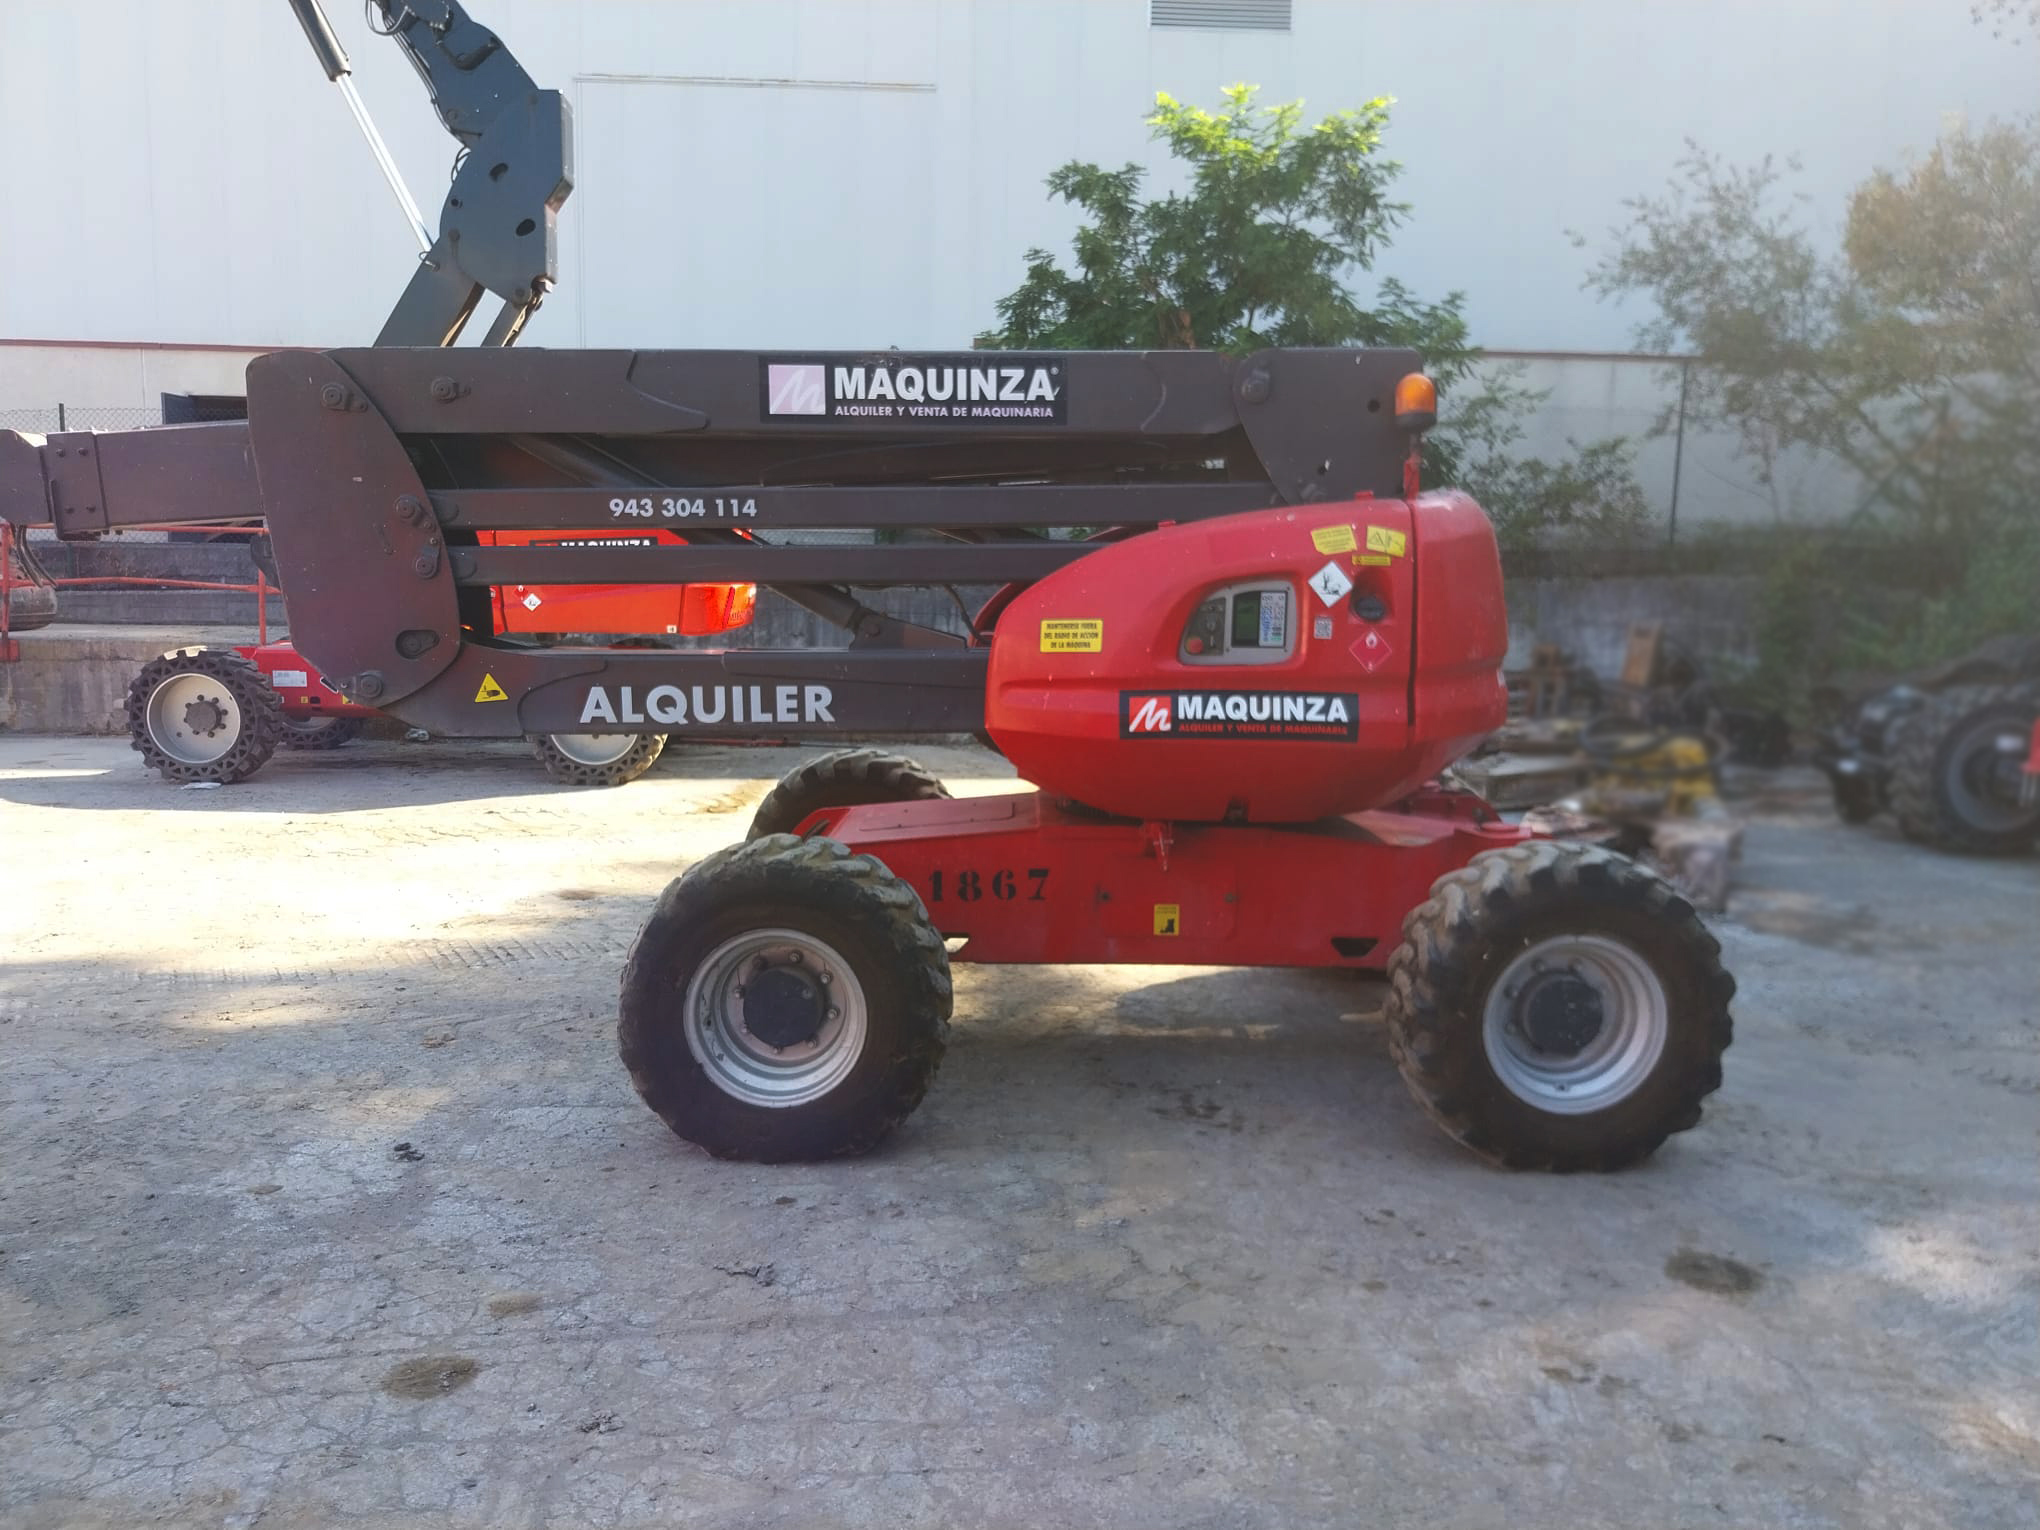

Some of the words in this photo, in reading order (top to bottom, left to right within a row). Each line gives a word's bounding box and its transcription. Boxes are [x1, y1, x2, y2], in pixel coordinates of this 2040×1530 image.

[835, 406, 893, 417] ALQUILER
[896, 406, 906, 416] Y
[909, 407, 948, 417] VENTA
[953, 407, 967, 417] DE
[971, 407, 1053, 418] MAQUINARIA
[609, 498, 654, 517] 943
[661, 498, 706, 517] 304
[715, 498, 758, 517] 114
[1071, 632, 1079, 640] DE
[579, 685, 835, 724] ALQUILER
[1177, 696, 1348, 722] MAQUINZA
[1178, 723, 1224, 733] ALQUILER
[1226, 723, 1233, 732] Y
[1236, 723, 1267, 733] VENTA
[1270, 724, 1282, 733] DE
[1284, 724, 1348, 735] MAQUINARIA
[928, 868, 1049, 901] 1867
